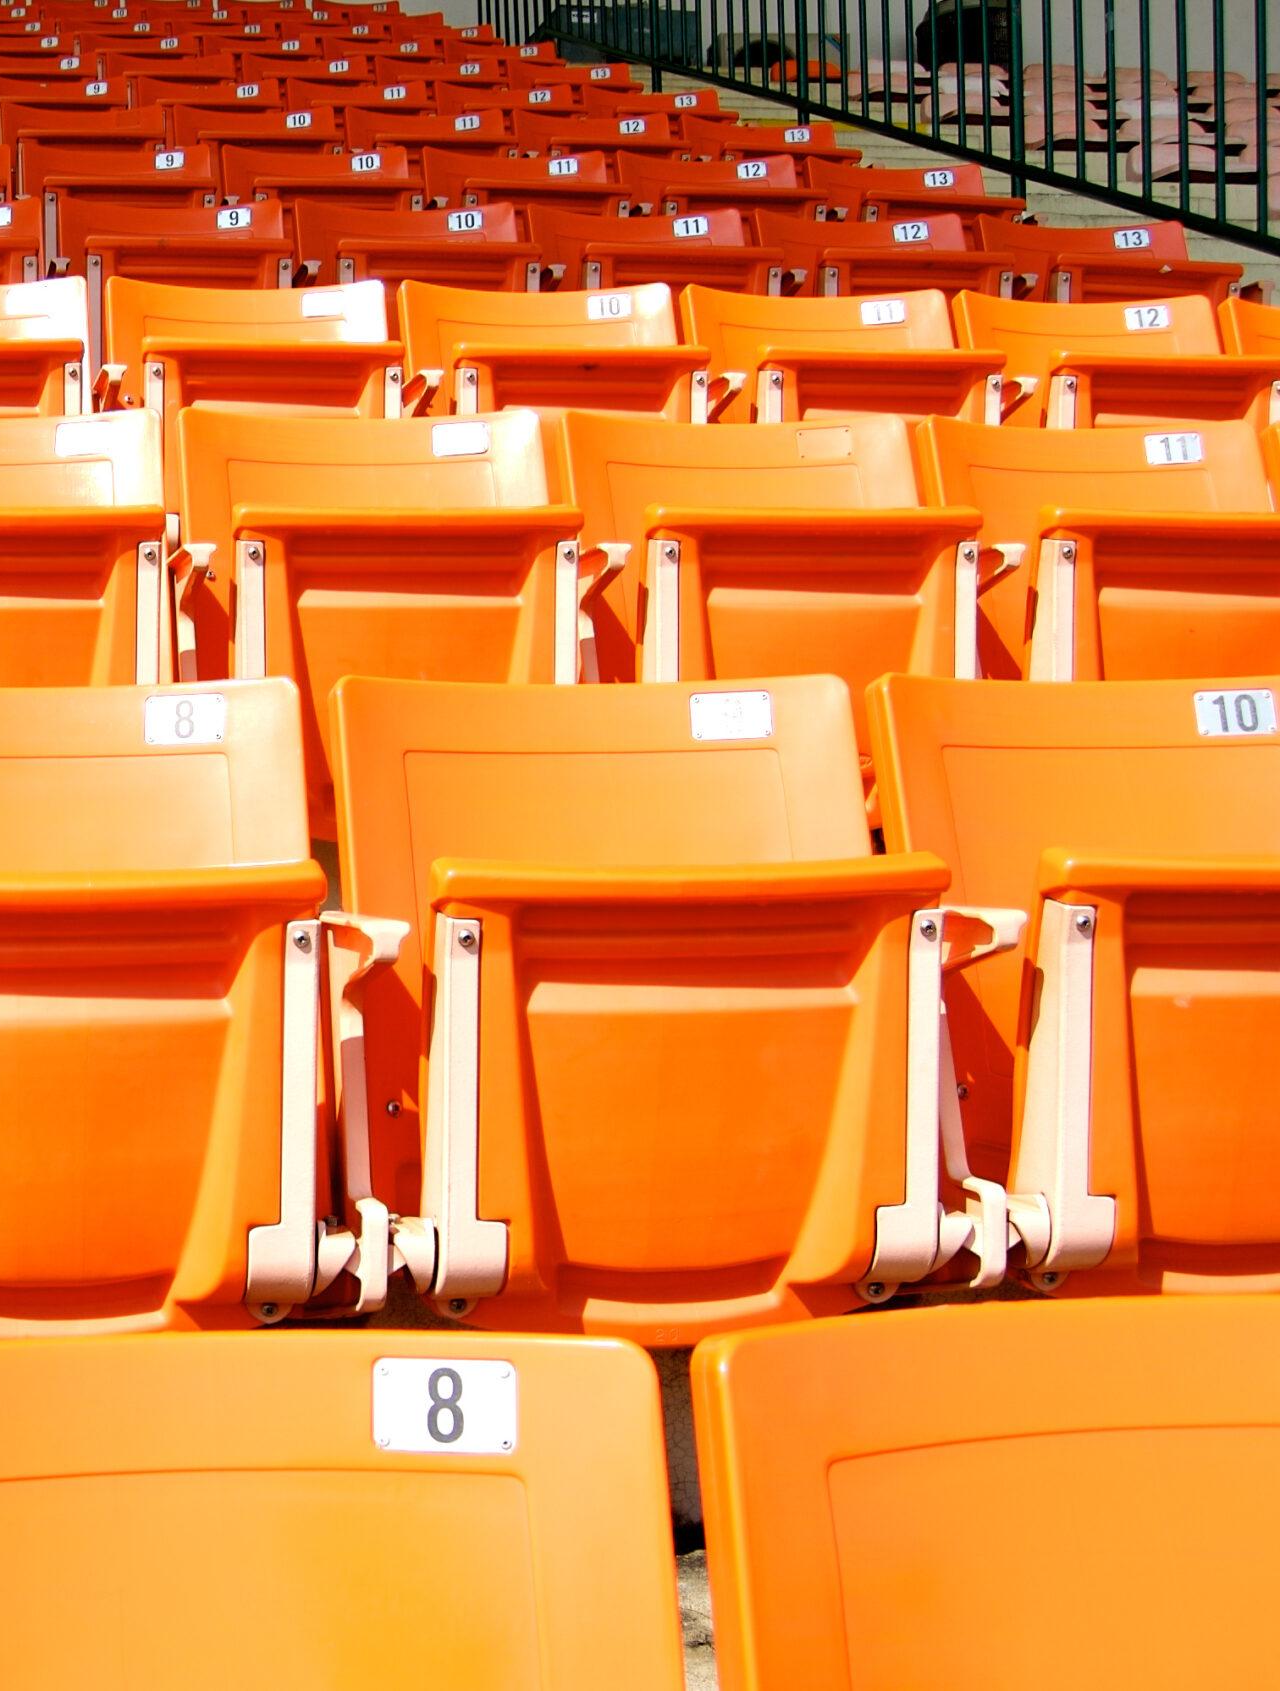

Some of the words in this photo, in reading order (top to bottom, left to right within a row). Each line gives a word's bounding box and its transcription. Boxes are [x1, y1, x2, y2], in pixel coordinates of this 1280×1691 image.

[404, 44, 414, 53] 12
[66, 59, 73, 68] 9
[335, 62, 344, 71] 11
[594, 69, 606, 78] 13
[390, 89, 401, 98] 11
[534, 92, 547, 101] 12
[680, 97, 693, 106] 13
[293, 115, 305, 125] 10
[463, 118, 473, 128] 11
[626, 121, 639, 132] 12
[791, 130, 804, 141] 13
[166, 155, 174, 166] 9
[359, 156, 373, 169] 10
[557, 161, 570, 173] 11
[745, 164, 760, 176] 12
[931, 173, 947, 185] 13
[230, 211, 238, 225] 9
[457, 214, 474, 228] 10
[683, 219, 699, 234] 11
[901, 225, 921, 239] 12
[1123, 232, 1142, 246] 13
[1135, 309, 1160, 327] 12
[1160, 436, 1188, 461] 11
[175, 700, 194, 738] 8
[1213, 694, 1259, 732] 10
[427, 1368, 464, 1443] 8
